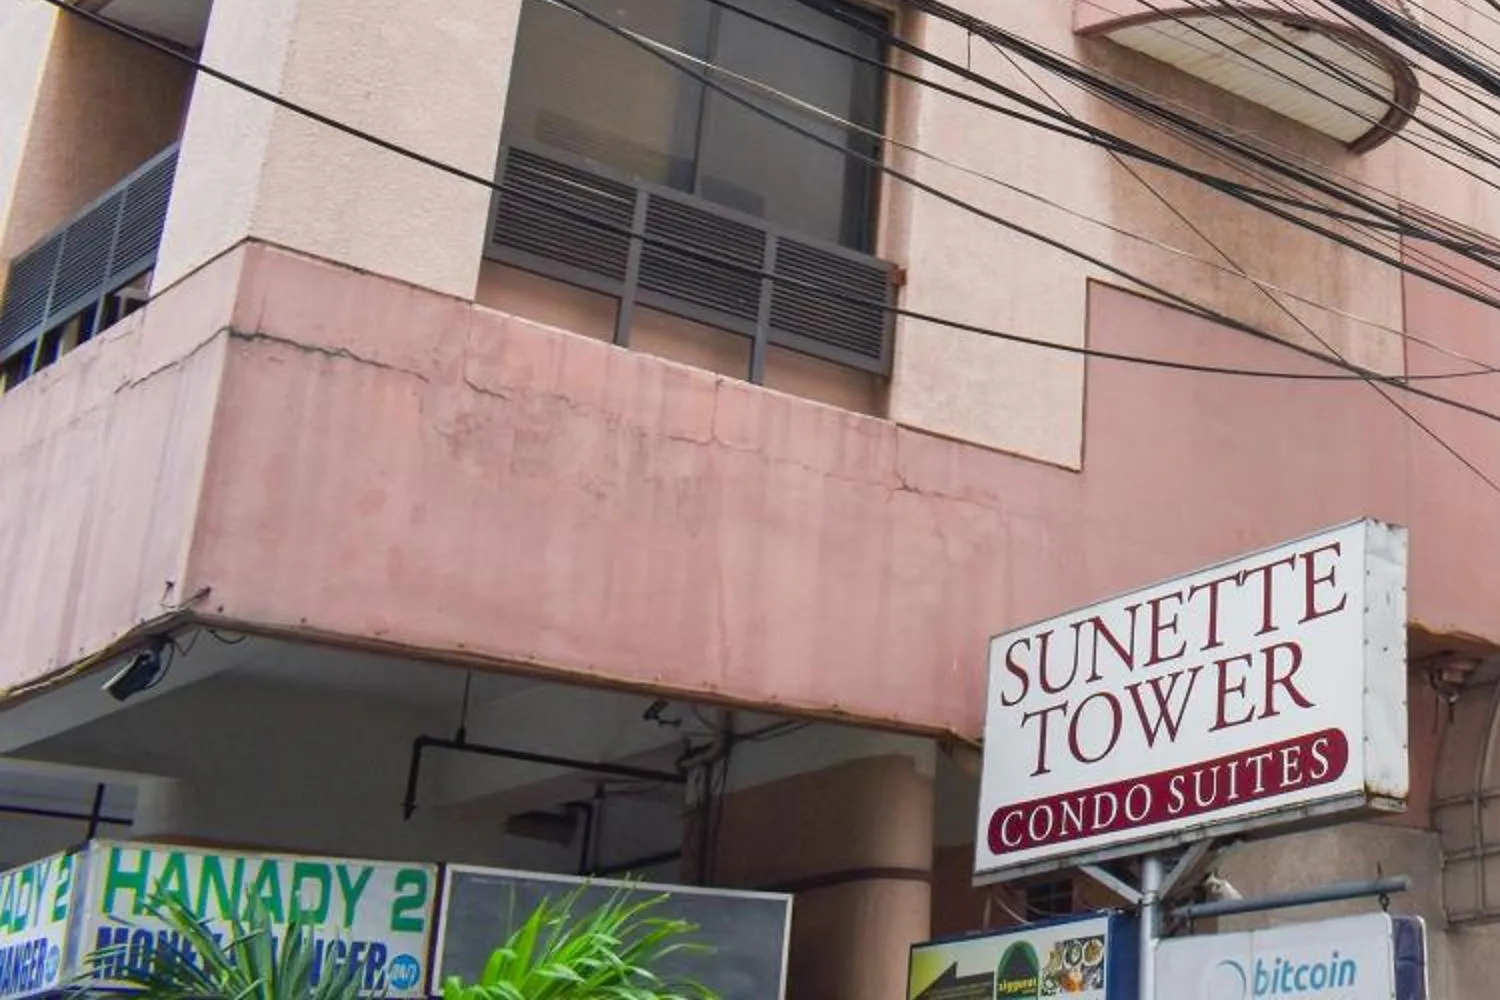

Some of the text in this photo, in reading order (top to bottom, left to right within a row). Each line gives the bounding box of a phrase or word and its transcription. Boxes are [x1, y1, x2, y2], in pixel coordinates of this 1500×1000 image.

[1000, 541, 1348, 707] SUNETTE
[1020, 641, 1317, 778] TOWER
[1000, 737, 1330, 848] CONDO SUITES
[102, 847, 427, 932] HANADY 2
[1253, 951, 1357, 996] bitcoin
